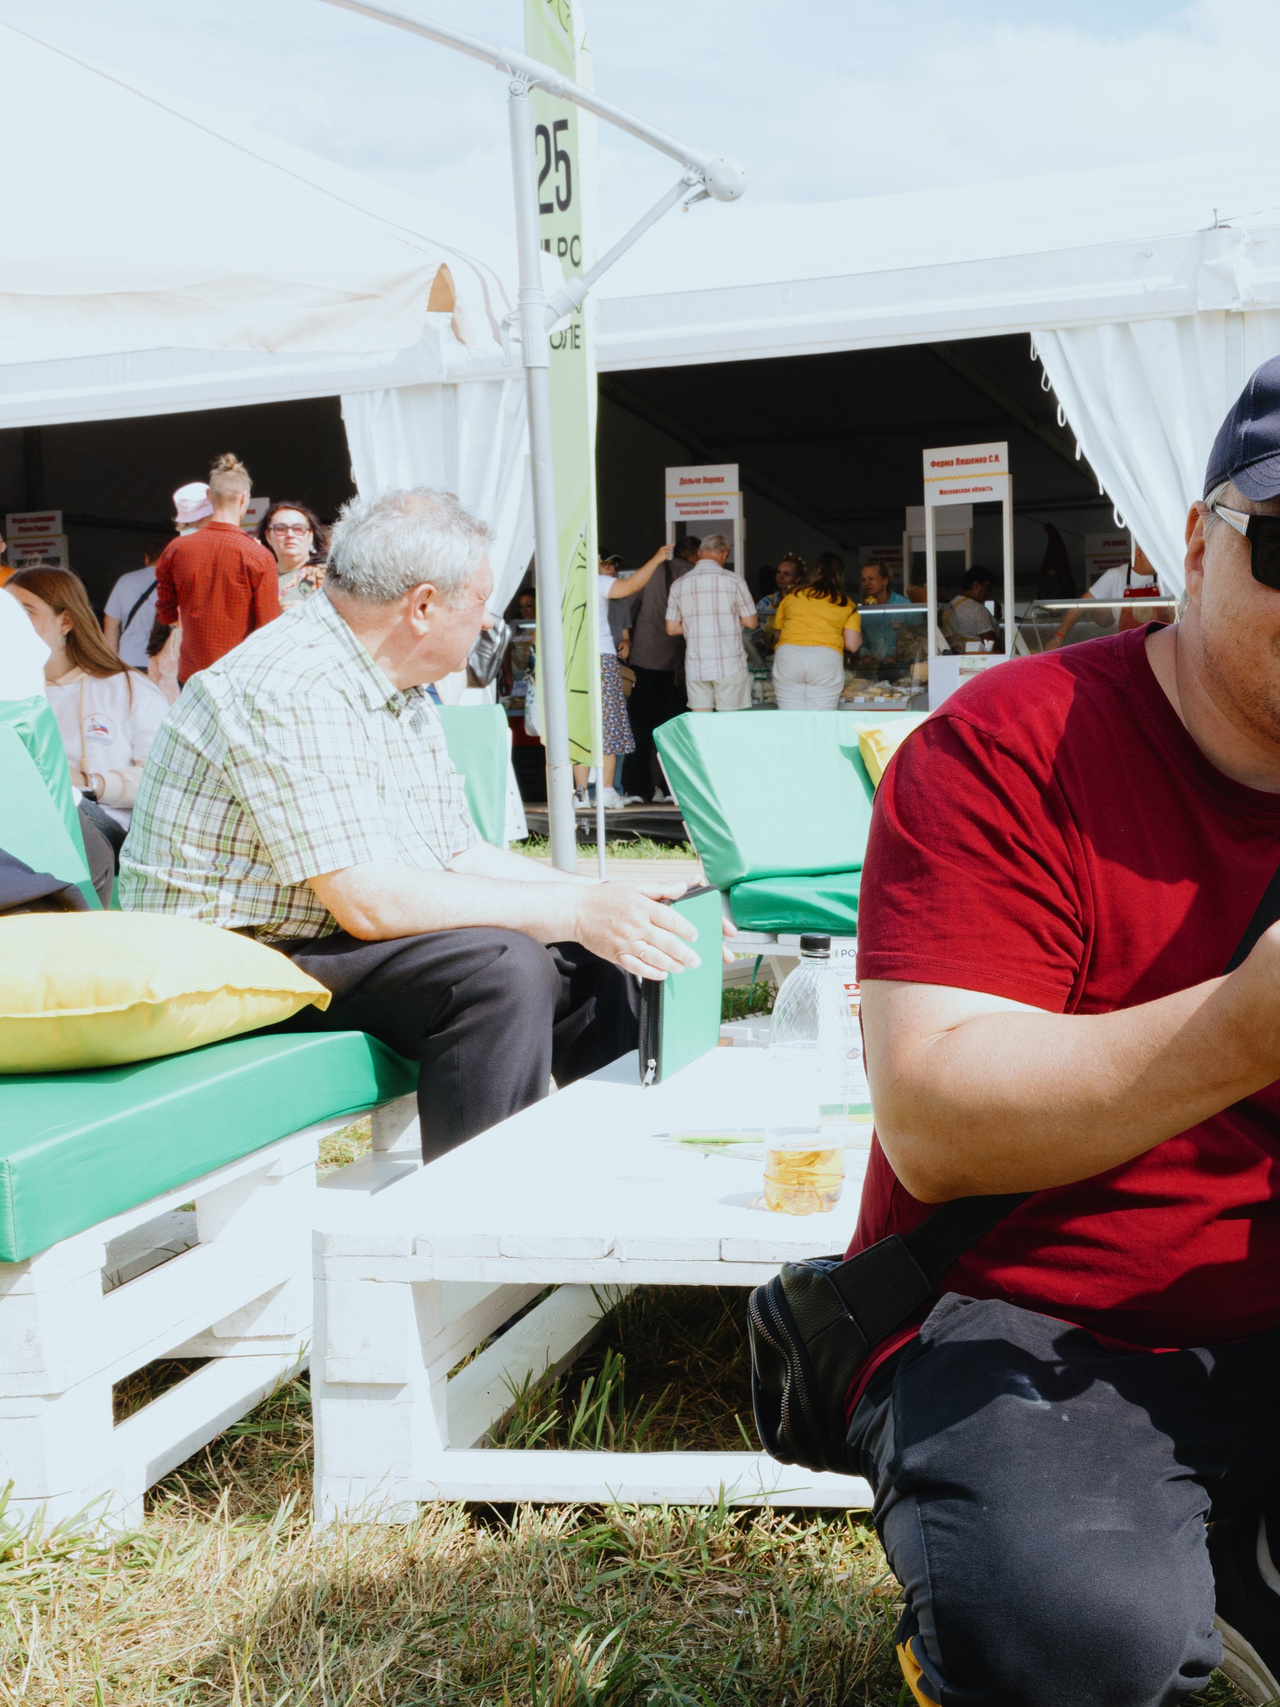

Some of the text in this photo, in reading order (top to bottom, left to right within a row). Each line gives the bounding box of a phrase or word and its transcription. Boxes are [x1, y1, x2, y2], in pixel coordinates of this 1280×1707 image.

[535, 119, 572, 215] 25
[930, 460, 955, 468] Ферма
[955, 456, 987, 466] Ляшенко
[939, 485, 993, 496] Московская область
[841, 949, 857, 958] РО
